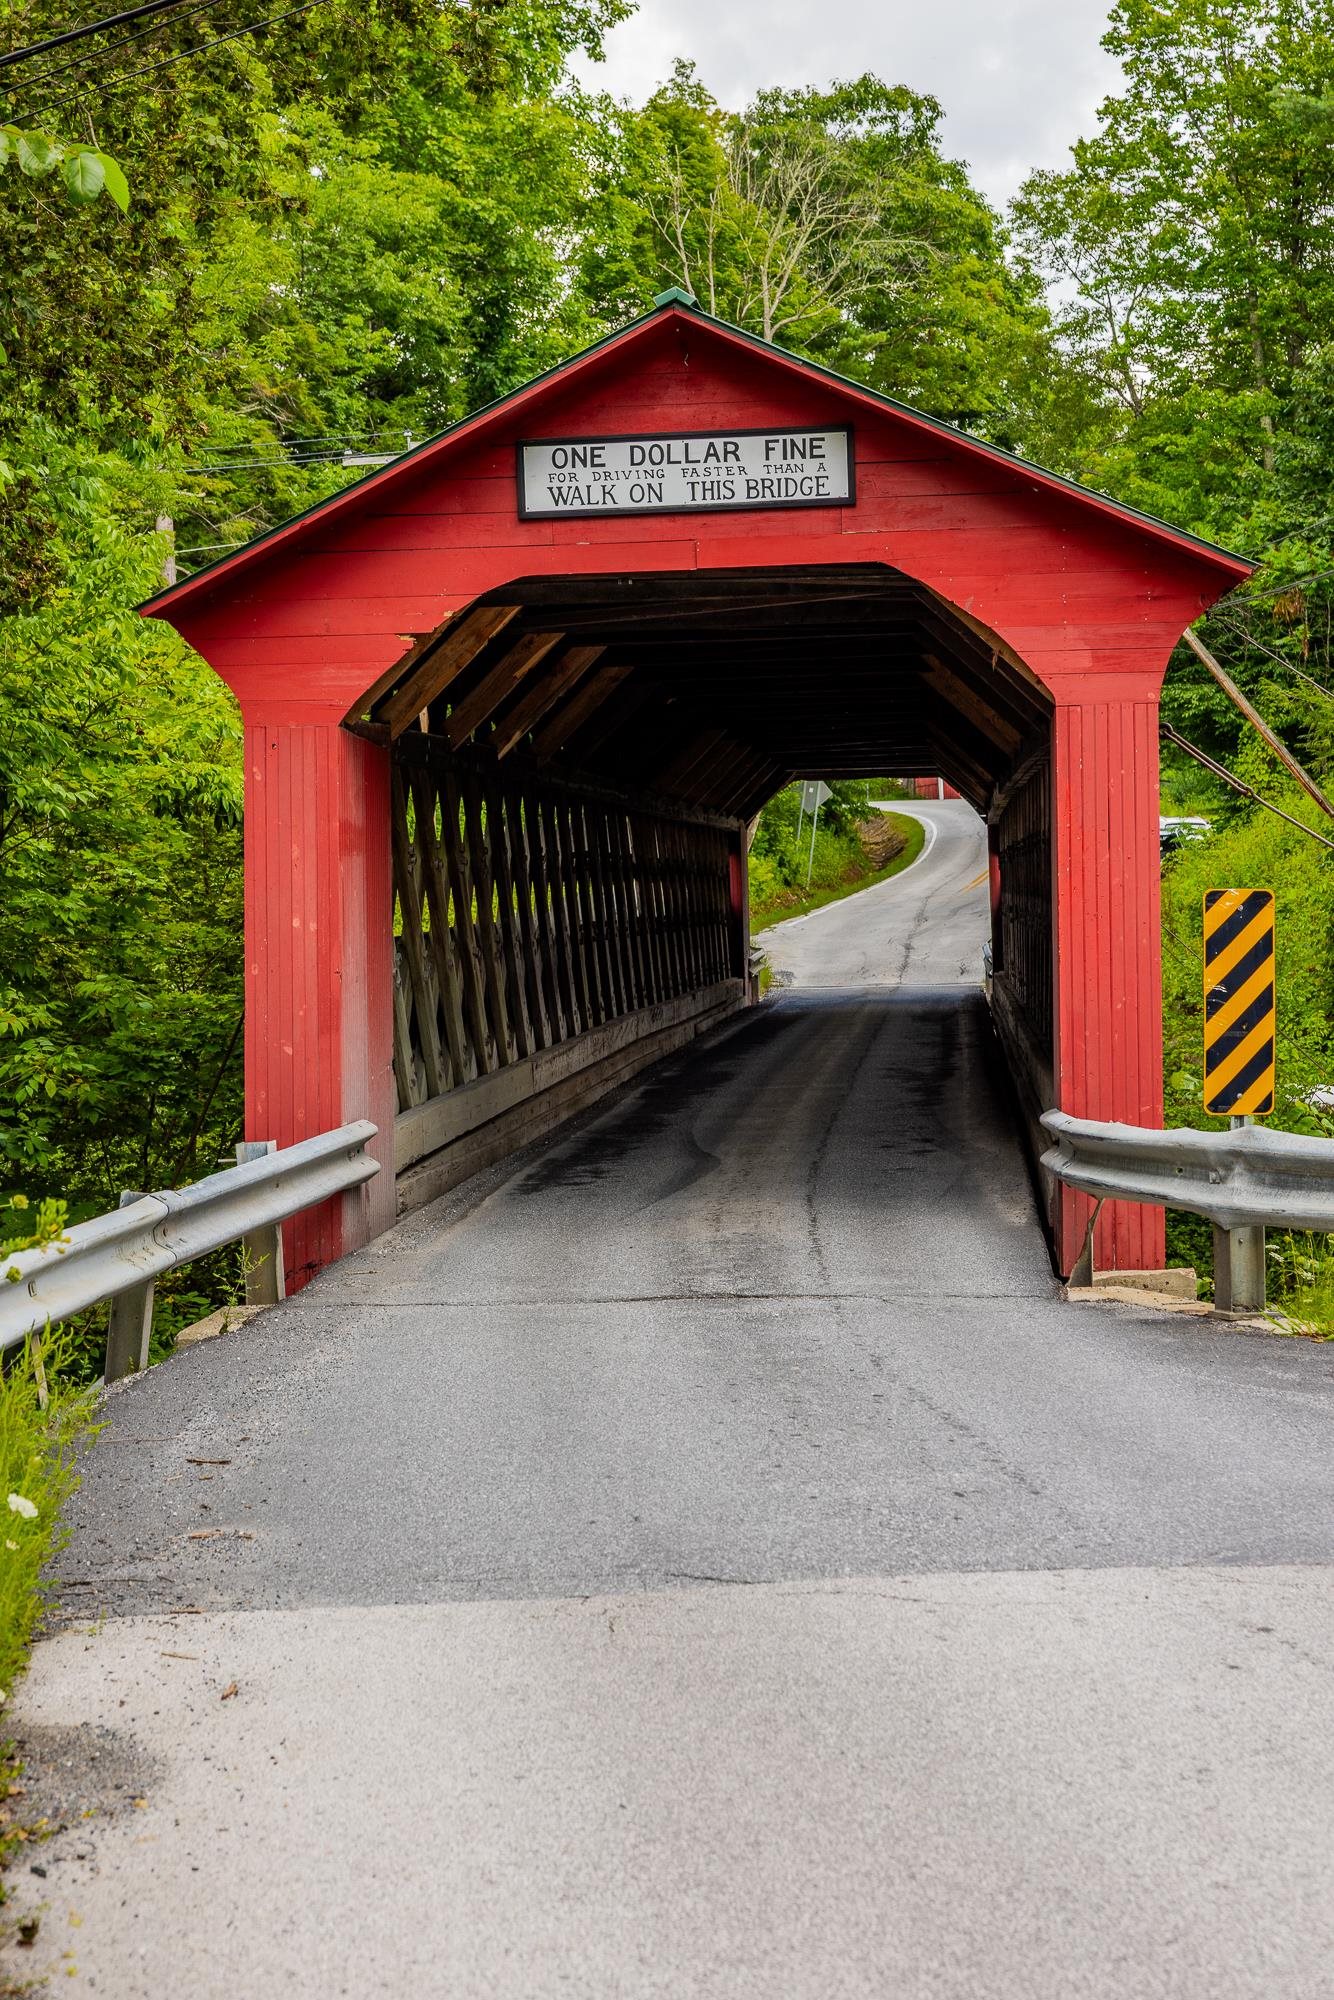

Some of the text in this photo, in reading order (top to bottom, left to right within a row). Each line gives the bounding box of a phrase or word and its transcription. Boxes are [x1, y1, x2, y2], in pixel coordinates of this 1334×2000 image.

[552, 437, 826, 469] ONE DOLLAR FINE
[548, 462, 827, 483] FOR DRIVING FASTER THAN A
[547, 475, 831, 507] WALK ON THIS BRIDGE
